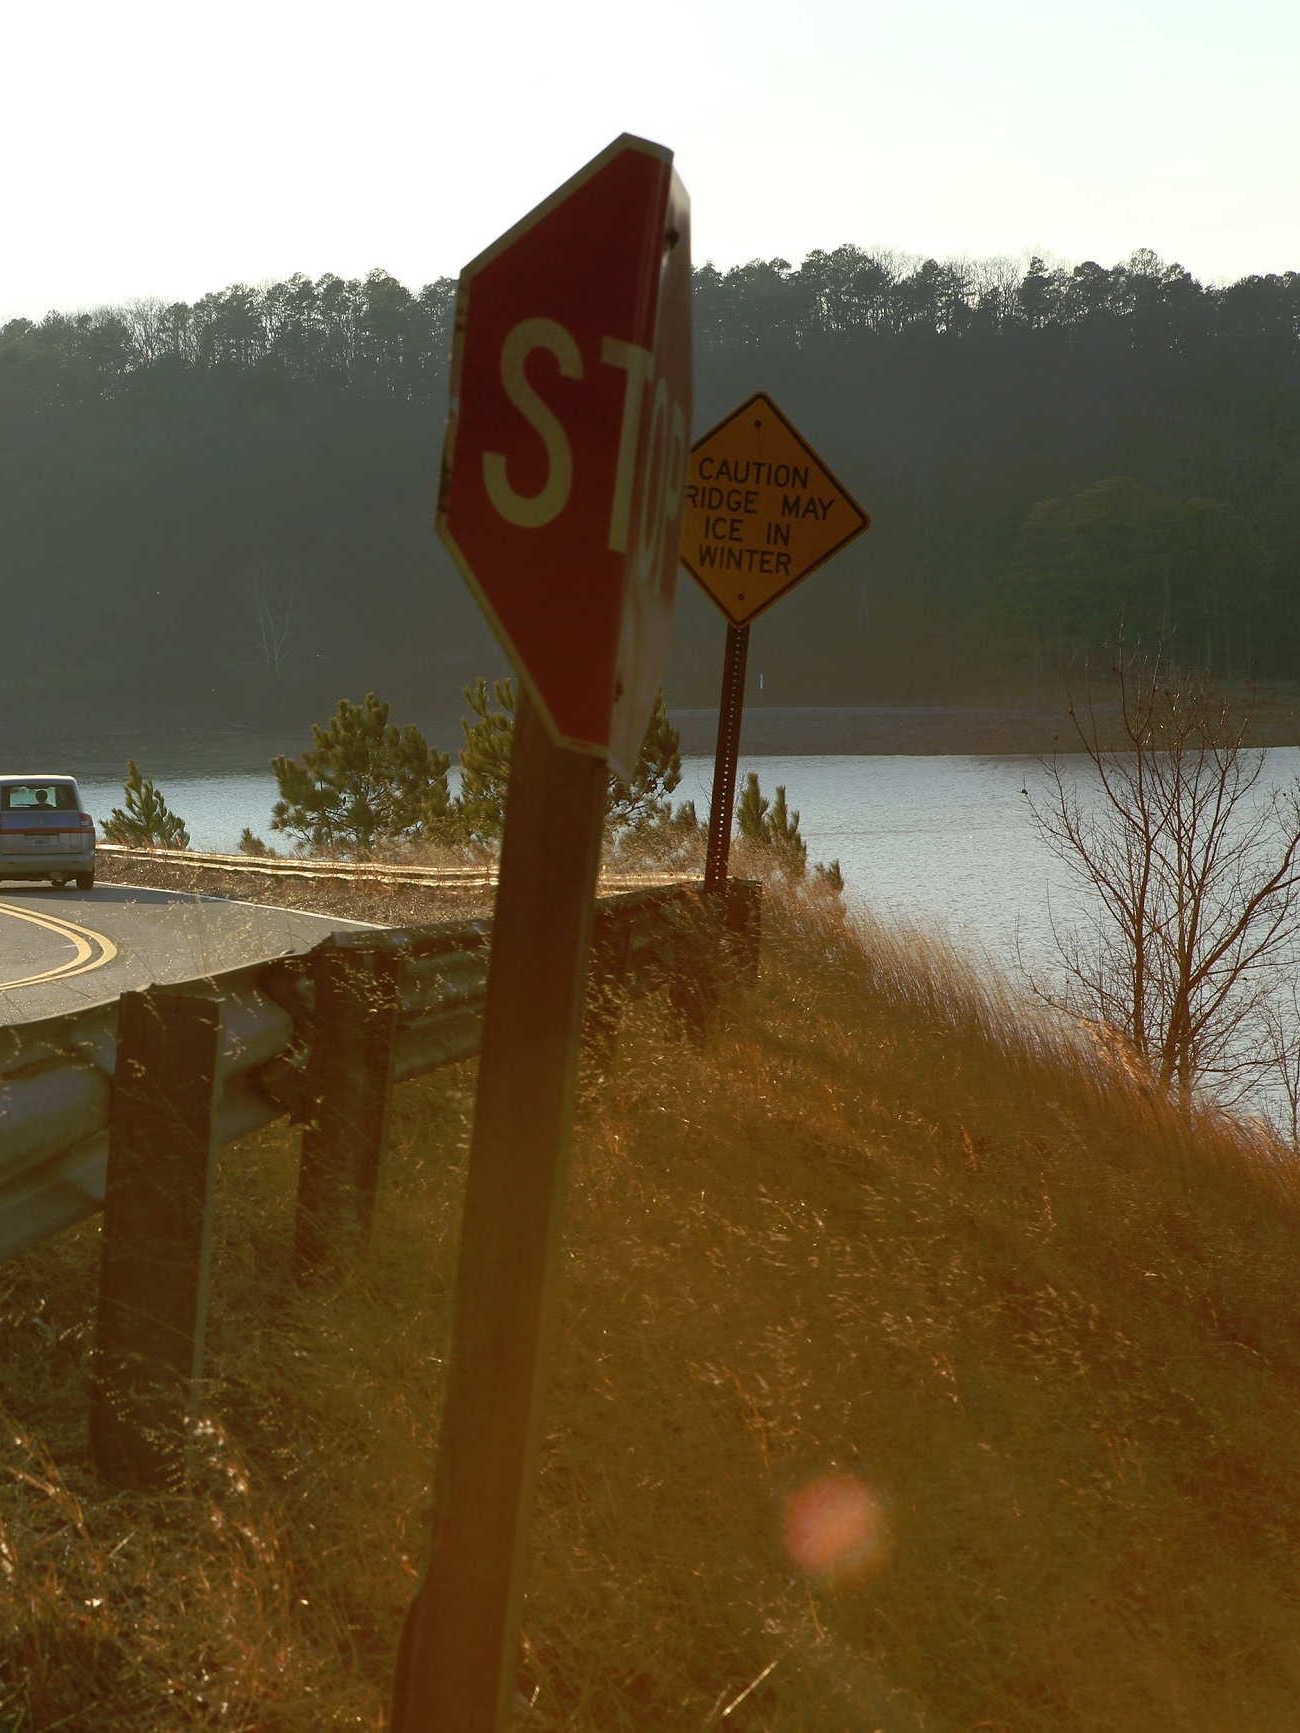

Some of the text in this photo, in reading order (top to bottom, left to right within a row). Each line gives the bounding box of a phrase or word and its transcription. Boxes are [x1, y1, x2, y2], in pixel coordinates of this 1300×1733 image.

[482, 317, 686, 597] STOP
[698, 457, 809, 490] CAUTION
[686, 485, 836, 521] RIDGE MAY
[704, 516, 791, 547] ICE IN
[698, 544, 792, 576] WINTER
